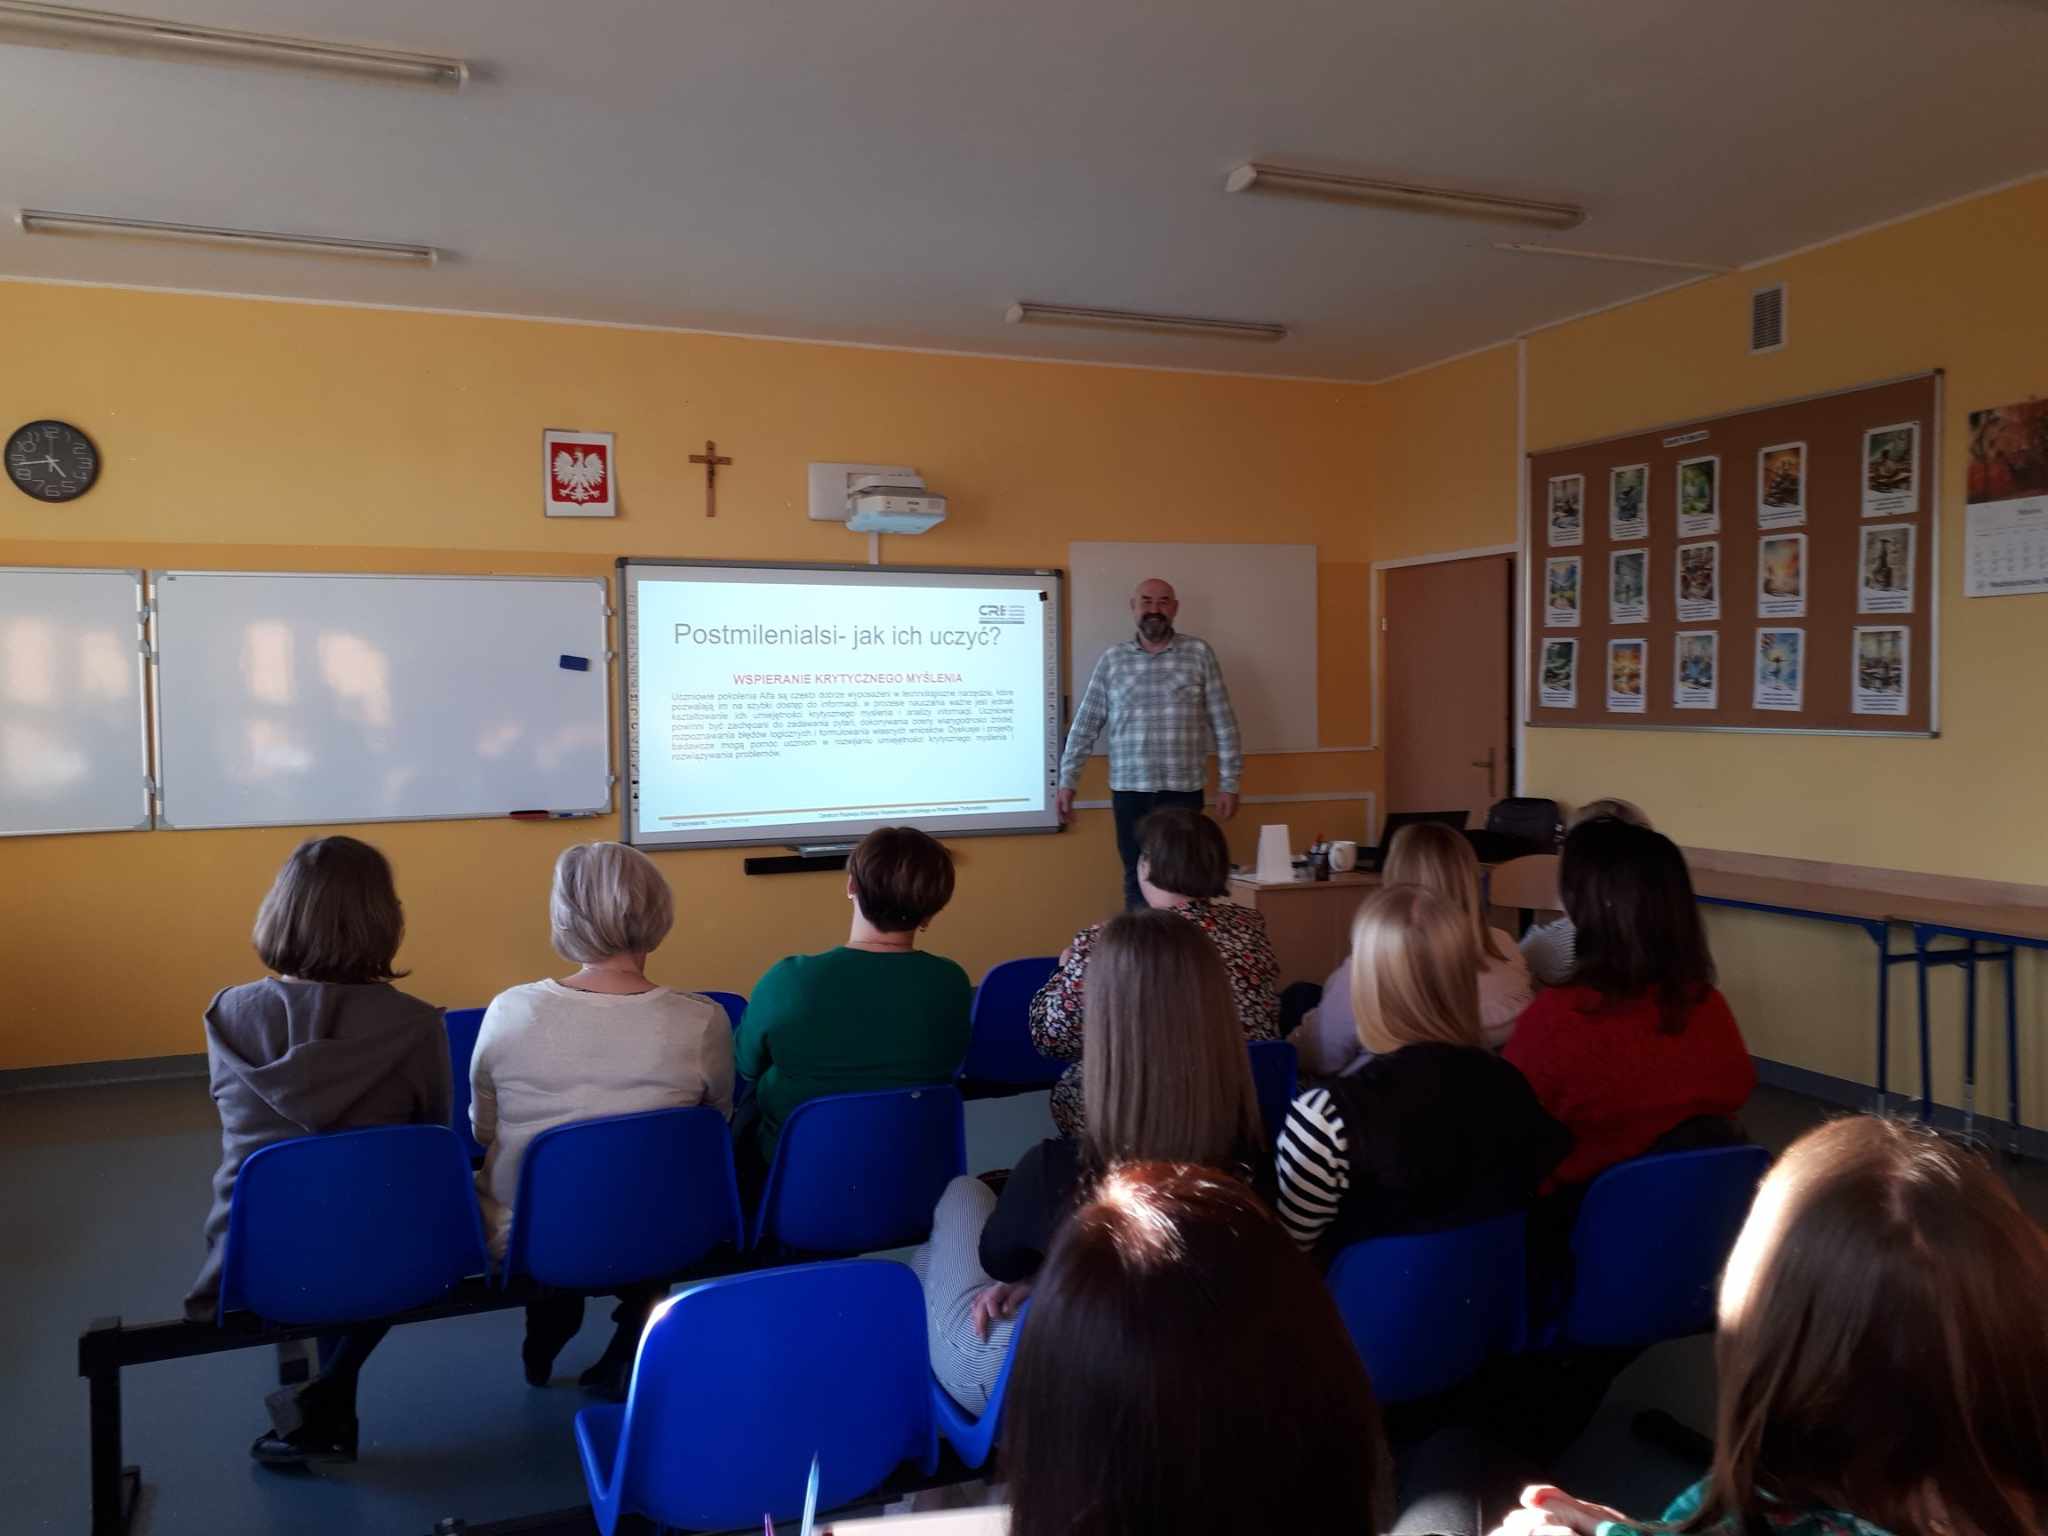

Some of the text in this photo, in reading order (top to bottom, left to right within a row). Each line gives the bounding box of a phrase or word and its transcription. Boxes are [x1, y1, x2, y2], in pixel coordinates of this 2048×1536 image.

[675, 623, 1001, 651] Postmilenialsi- jak ich uczyć?
[733, 671, 963, 685] WSPIERANIE KRYTYCZNEGO MYŚLENIA
